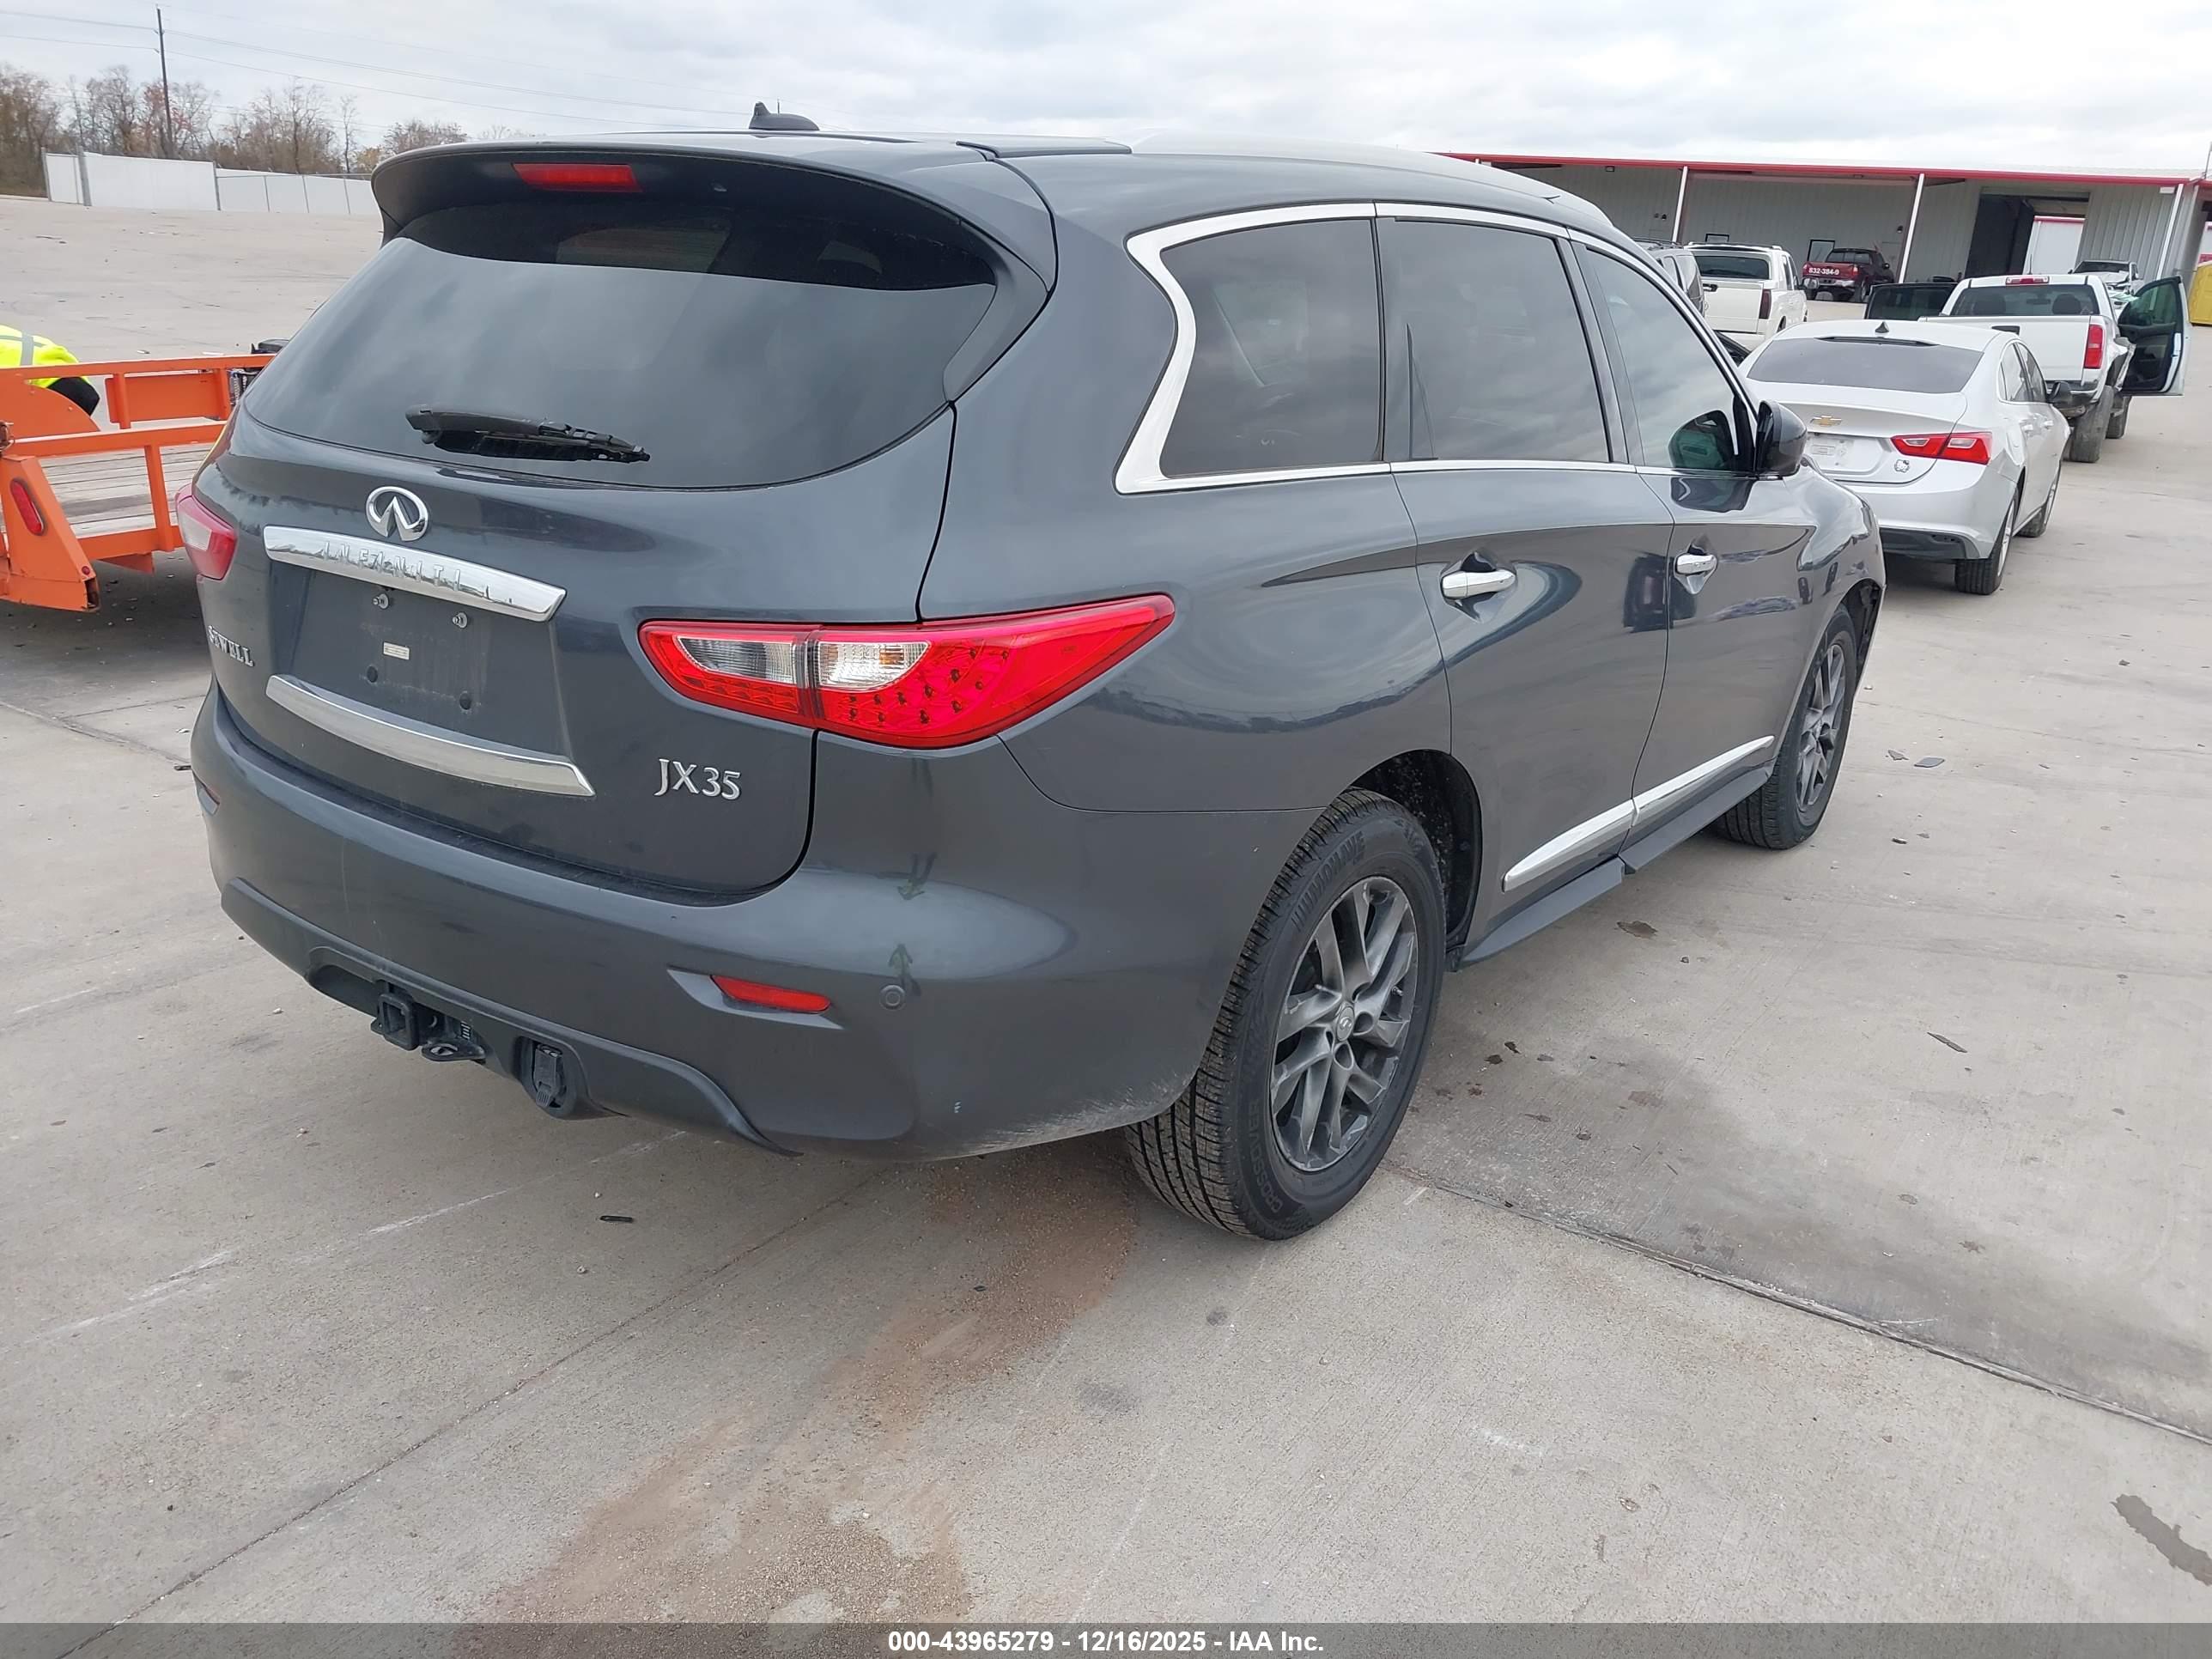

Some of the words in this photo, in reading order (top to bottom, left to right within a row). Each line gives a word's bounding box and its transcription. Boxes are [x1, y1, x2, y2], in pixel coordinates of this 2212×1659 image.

[323, 540, 462, 592] INFINITI
[653, 758, 741, 800] JX35
[1248, 1098, 1284, 1213] CROSSOVER
